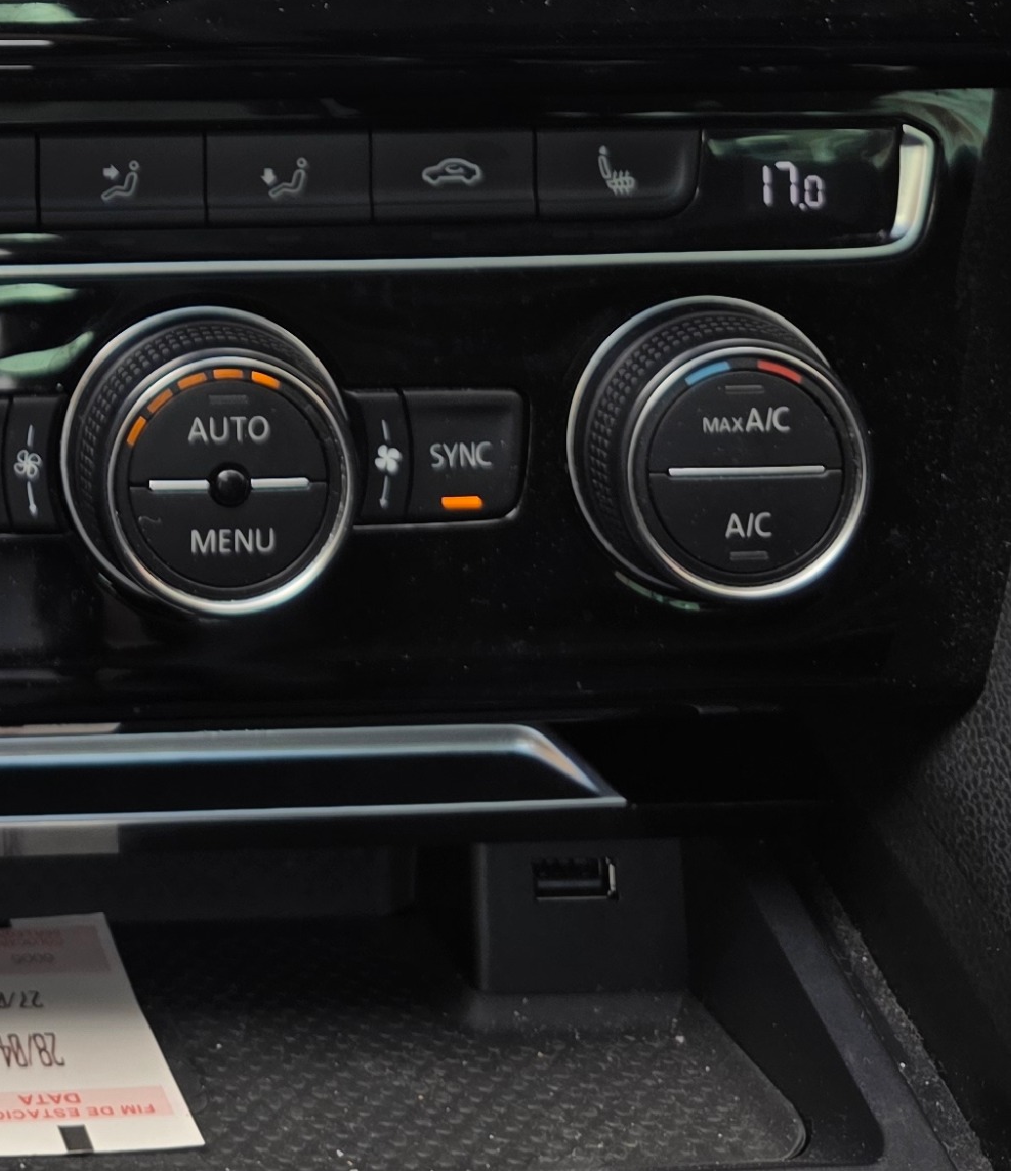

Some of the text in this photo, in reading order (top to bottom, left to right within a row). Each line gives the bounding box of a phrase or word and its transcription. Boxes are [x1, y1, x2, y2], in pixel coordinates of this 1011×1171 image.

[188, 416, 271, 444] AUTO
[746, 406, 791, 433] A/C
[430, 441, 493, 469] SYNC
[725, 512, 772, 538] A/C
[190, 528, 276, 554] MENU
[18, 1093, 82, 1105] DATA
[87, 1105, 116, 1117] DE
[121, 1103, 156, 1116] FIM
